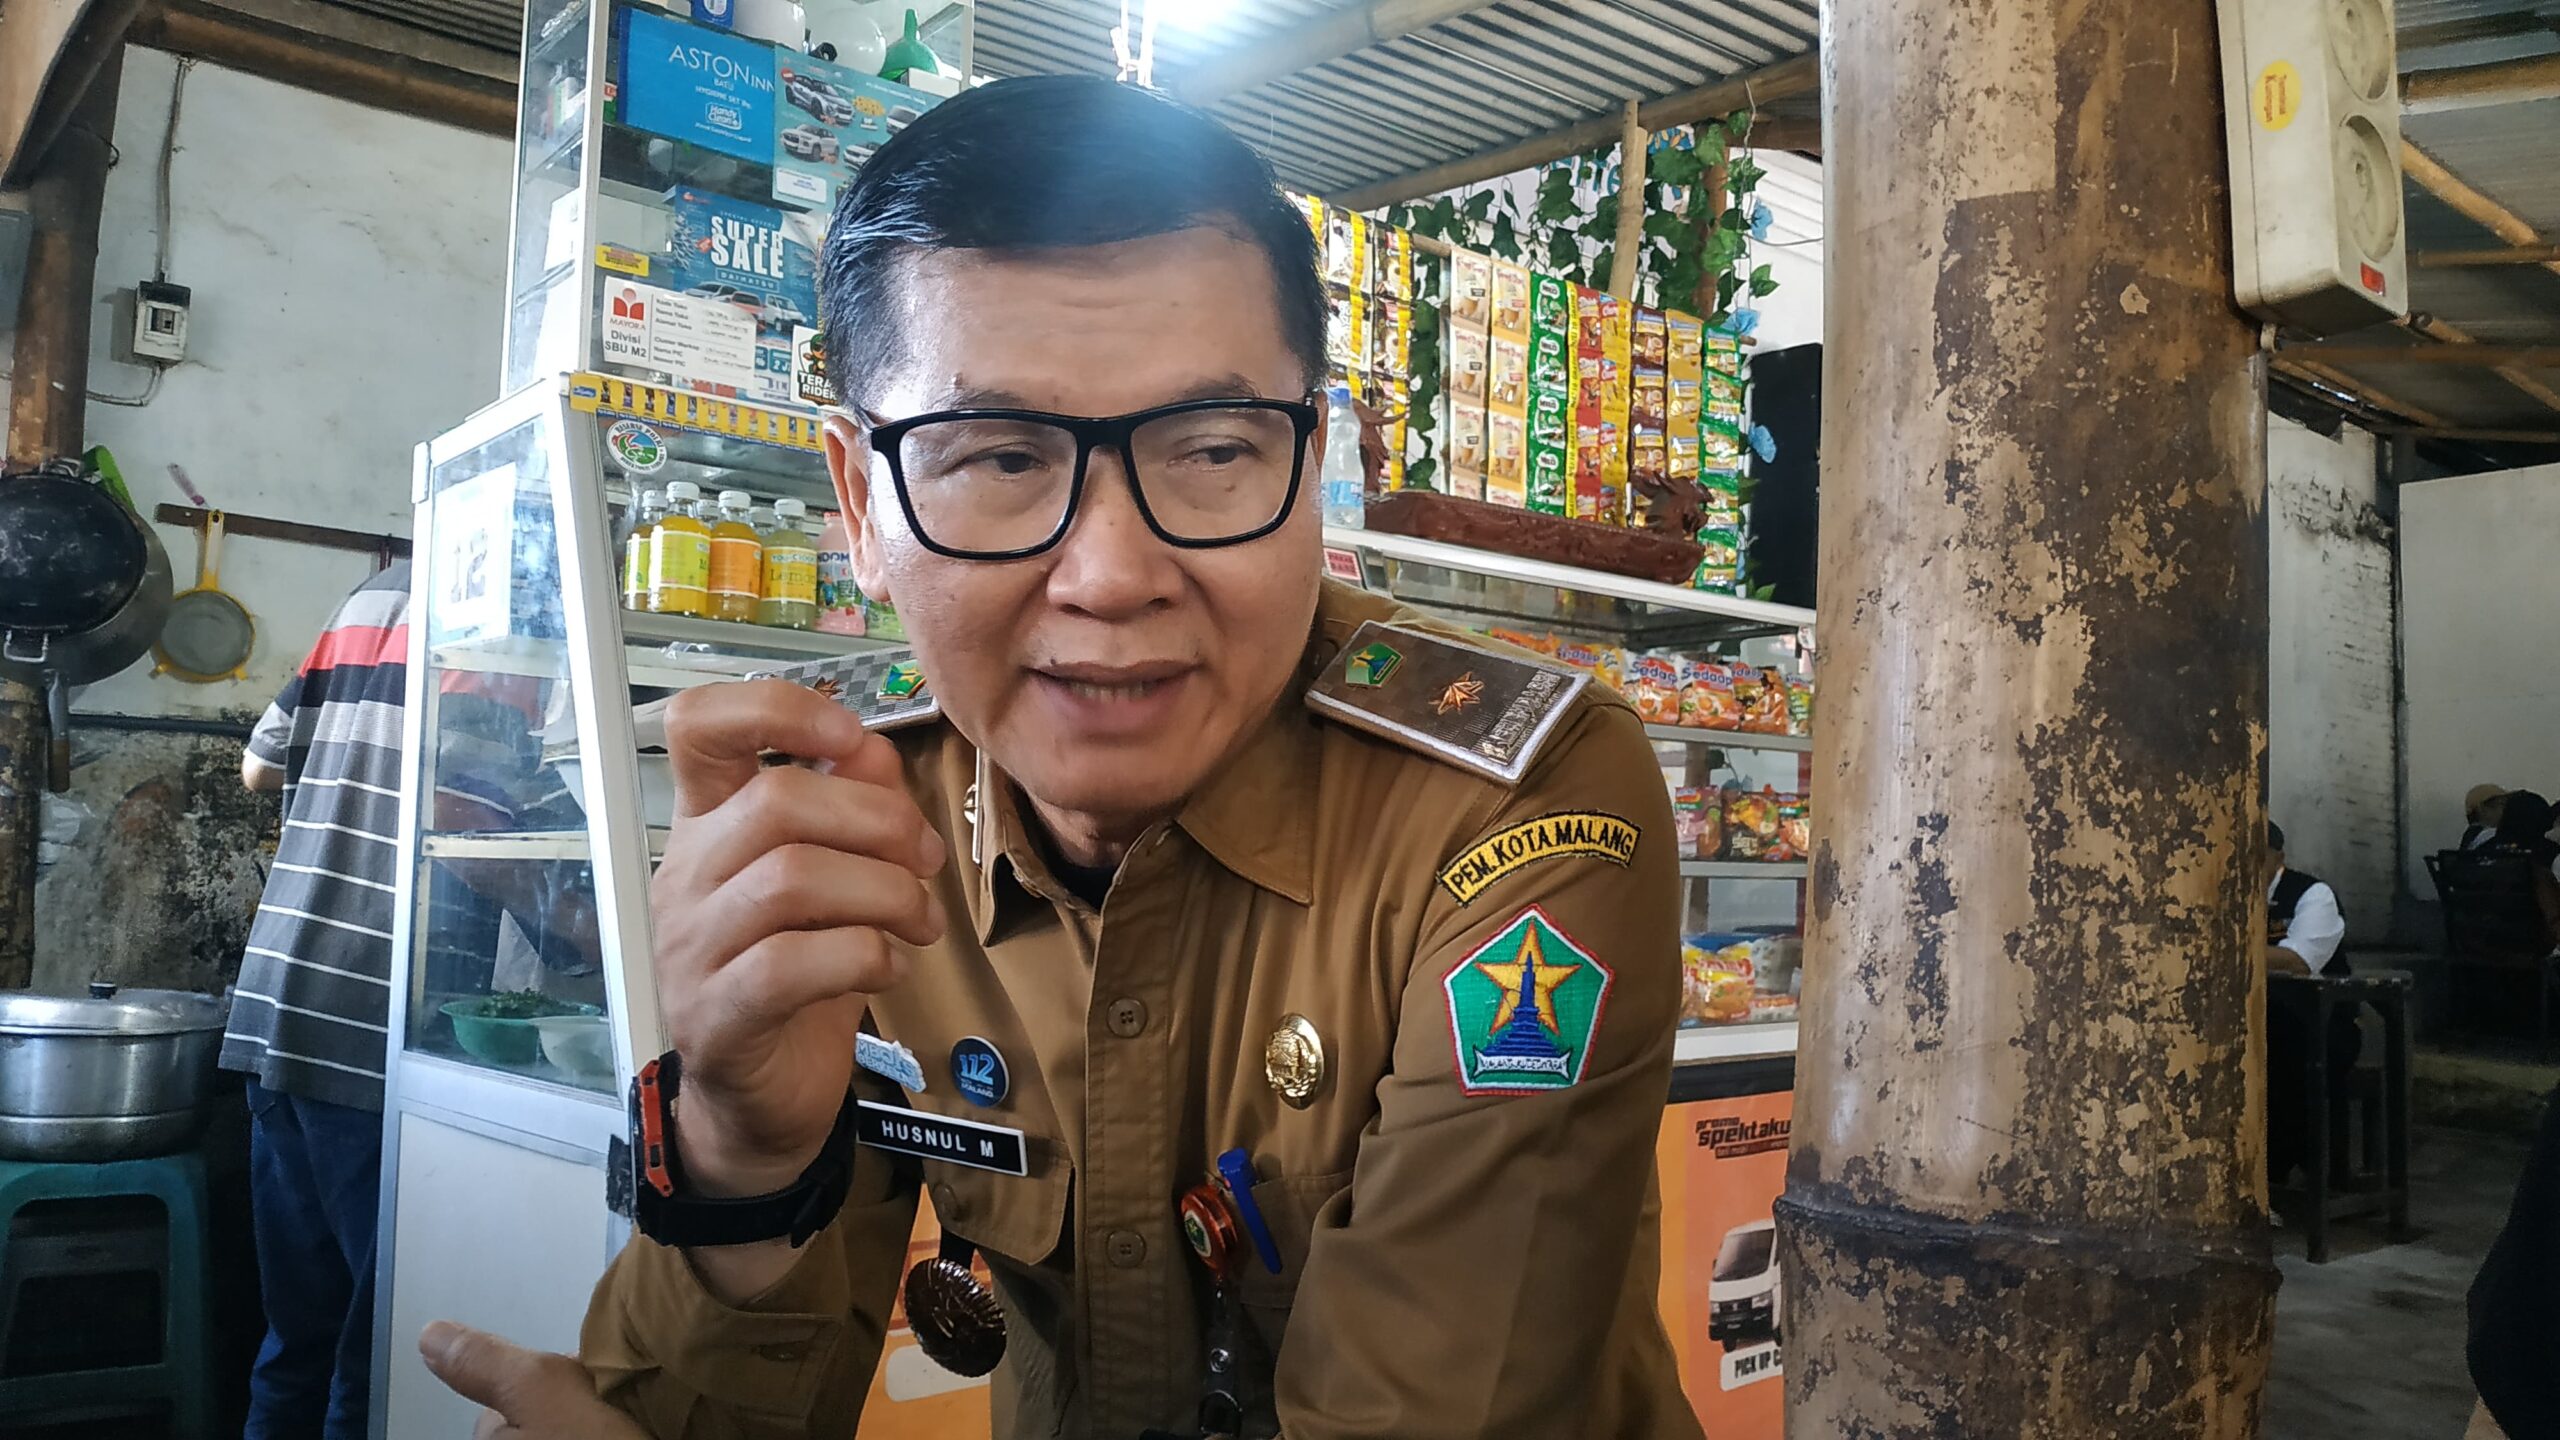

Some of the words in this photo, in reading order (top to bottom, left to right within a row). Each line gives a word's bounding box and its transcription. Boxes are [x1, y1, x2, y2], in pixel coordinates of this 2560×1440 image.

[668, 44, 750, 84] ASTON
[710, 104, 738, 120] Handy
[711, 215, 784, 249] SUPER
[711, 233, 785, 279] SALE
[720, 271, 775, 289] DAIHATSU
[1541, 283, 1558, 295] MILO
[609, 317, 646, 331] MAYORA
[611, 329, 642, 345] Divisi
[604, 340, 628, 354] SBU
[631, 346, 648, 358] M2
[1540, 342, 1557, 353] MILO
[1539, 398, 1557, 409] MILO
[1540, 455, 1557, 466] MILO
[1681, 667, 1733, 686] Sedaap
[1491, 824, 1549, 866] KOTA
[1555, 819, 1634, 857] MALANG
[958, 1053, 996, 1086] 112
[1695, 1116, 1740, 1134] promo
[1698, 1117, 1792, 1150] spektaku
[881, 1119, 967, 1152] HUSNUL
[979, 1138, 994, 1158] M
[1734, 1355, 1757, 1379] PICK
[1758, 1350, 1771, 1371] UP
